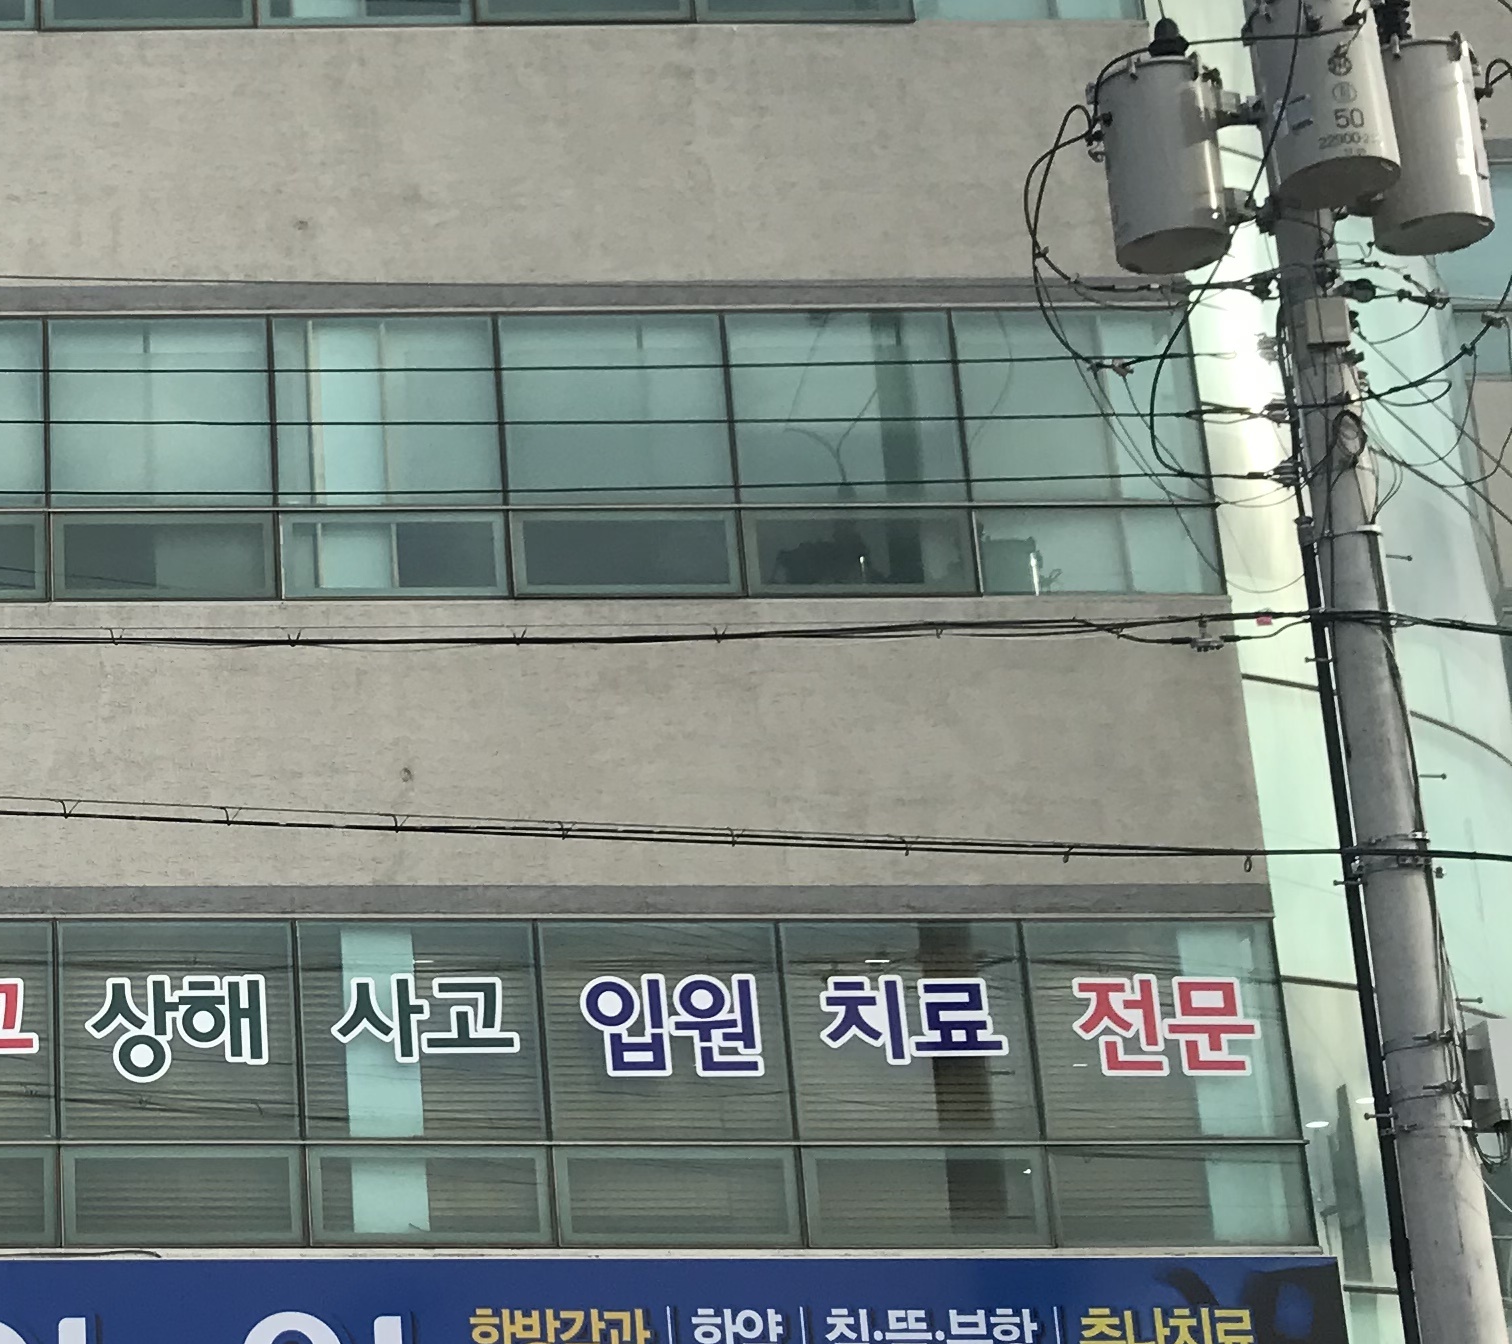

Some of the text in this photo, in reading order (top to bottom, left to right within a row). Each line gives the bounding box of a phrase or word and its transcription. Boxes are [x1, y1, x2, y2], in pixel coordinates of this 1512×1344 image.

[1333, 107, 1365, 129] 50
[86, 973, 268, 1083] 상해
[332, 973, 521, 1064] 사고
[580, 973, 766, 1078] 입원
[819, 974, 1009, 1065] 치료
[1071, 973, 1262, 1078] 전문
